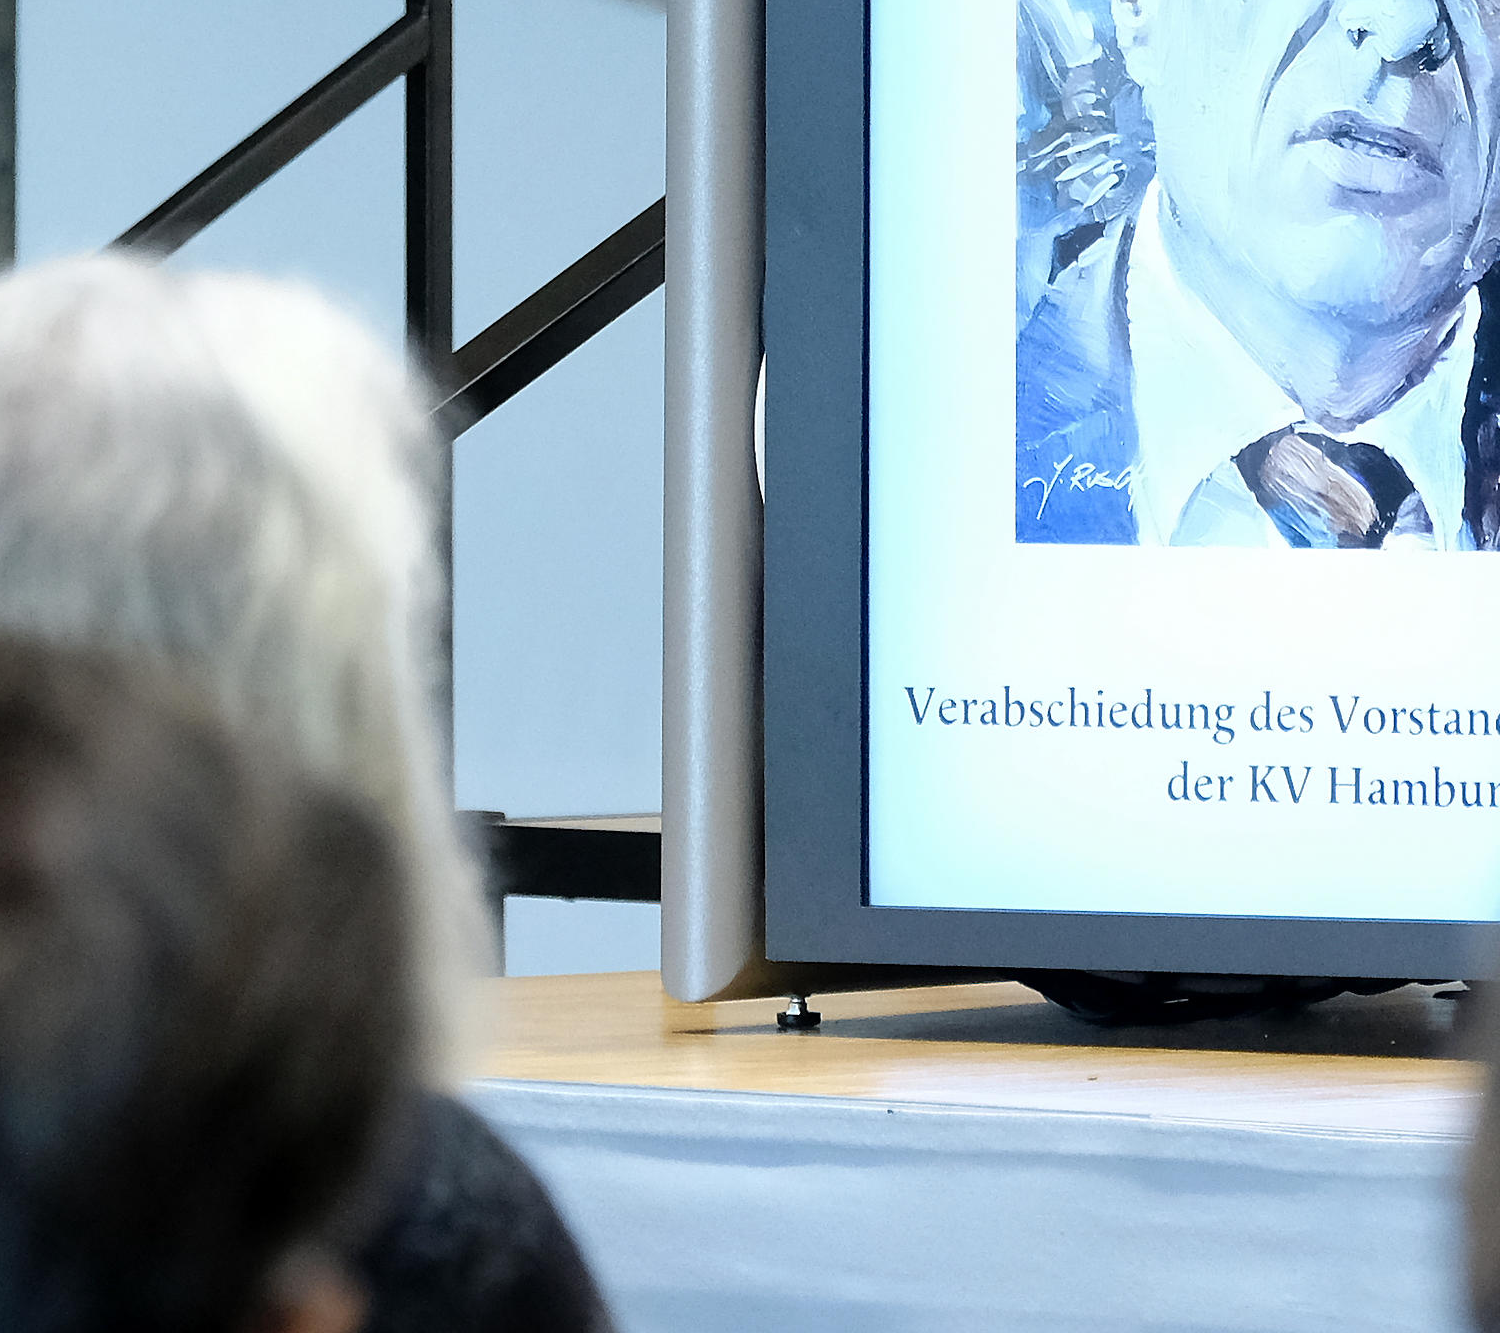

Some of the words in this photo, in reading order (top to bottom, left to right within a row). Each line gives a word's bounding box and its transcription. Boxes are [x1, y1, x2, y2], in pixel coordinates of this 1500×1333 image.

[903, 685, 1235, 745] Verabschiedung
[1249, 690, 1314, 733] des
[1167, 760, 1234, 802] der
[1249, 765, 1312, 804] KV
